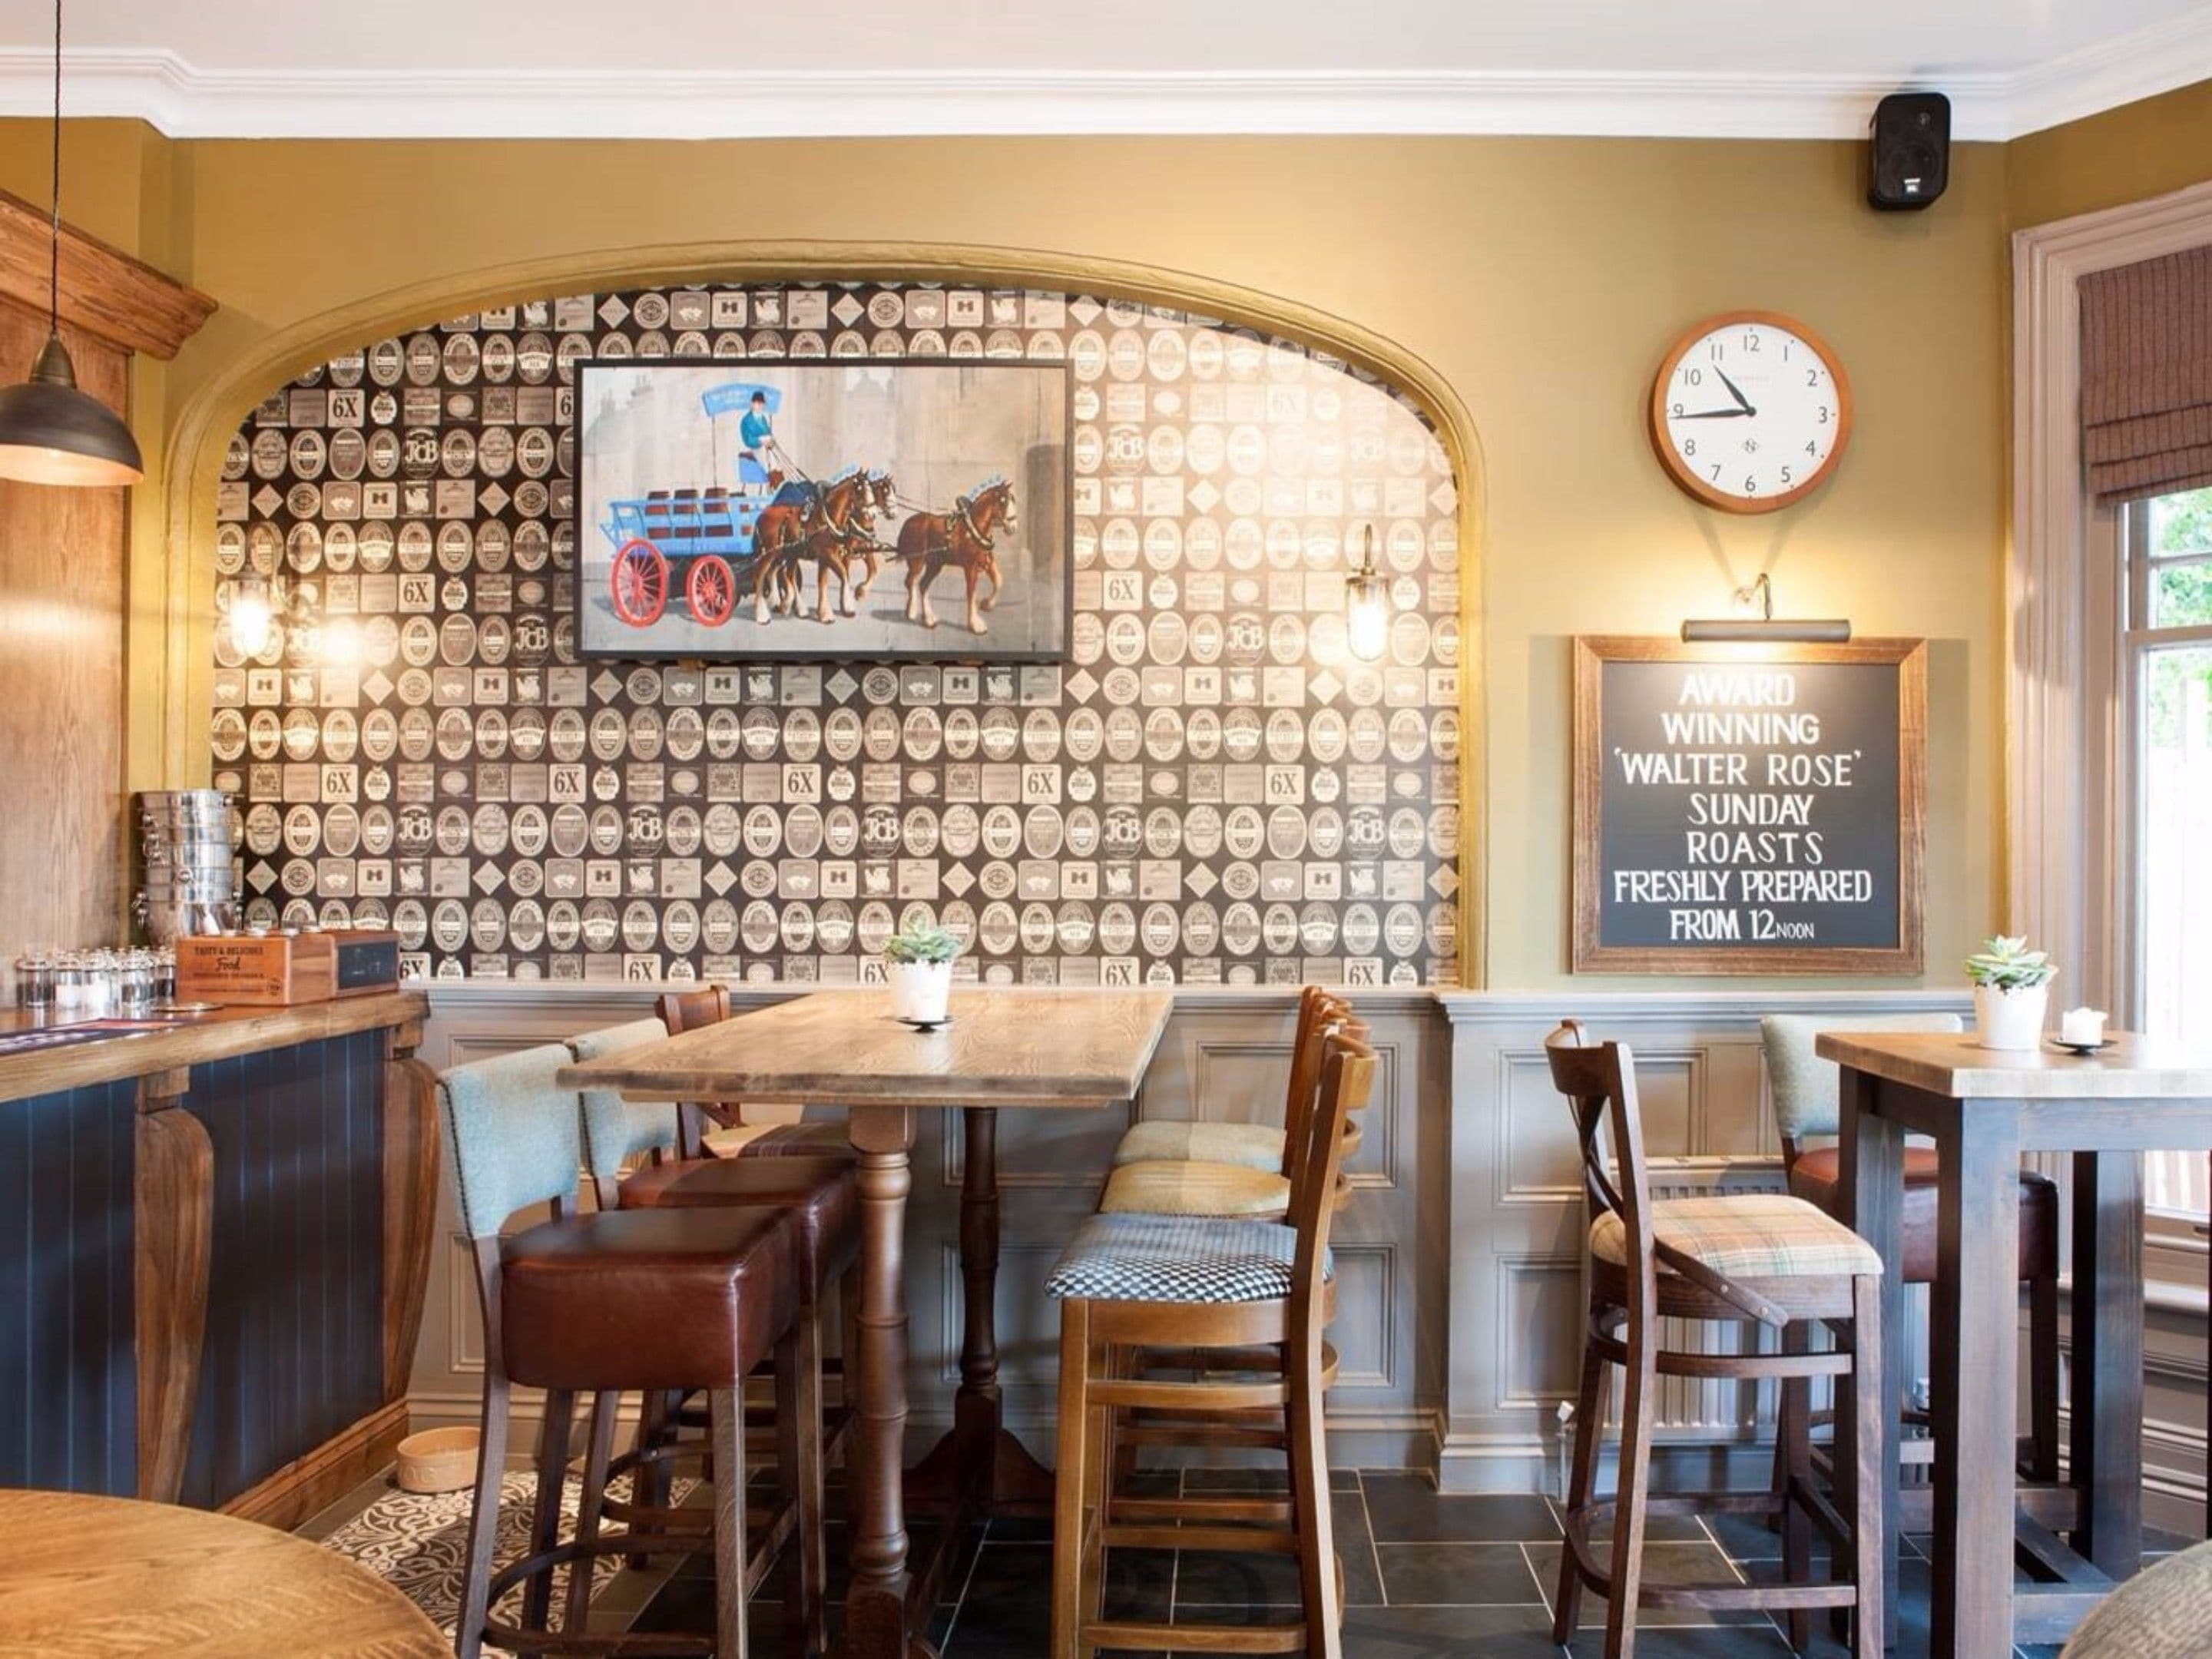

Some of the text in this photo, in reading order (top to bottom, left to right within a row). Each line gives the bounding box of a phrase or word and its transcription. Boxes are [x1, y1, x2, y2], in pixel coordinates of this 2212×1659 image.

[1710, 344, 1724, 361] 11
[1743, 334, 1760, 353] 12
[1683, 369, 1701, 386] 10
[1806, 370, 1817, 387] 2
[332, 396, 357, 419] 6X
[1673, 403, 1684, 419] 9
[1818, 406, 1828, 424] 3
[1684, 439, 1696, 455] 8
[1805, 440, 1816, 457] 4
[1710, 464, 1721, 481] 7
[1744, 475, 1756, 492] 6
[1780, 466, 1791, 483] 5
[402, 581, 428, 603] 6X
[1108, 578, 1134, 601] 6X
[1679, 672, 1796, 706] AWARD
[1661, 713, 1820, 745] WINNING
[326, 771, 351, 793] 6X
[554, 771, 579, 793] 6X
[787, 771, 813, 793] 6X
[1028, 772, 1053, 794] 6X
[1270, 772, 1296, 794] 6X
[1687, 793, 1815, 826] SUNDAY
[1686, 831, 1823, 864] ROASTS
[1614, 871, 1872, 902] FRESHLY PREPARED
[1670, 909, 1741, 941] FROM
